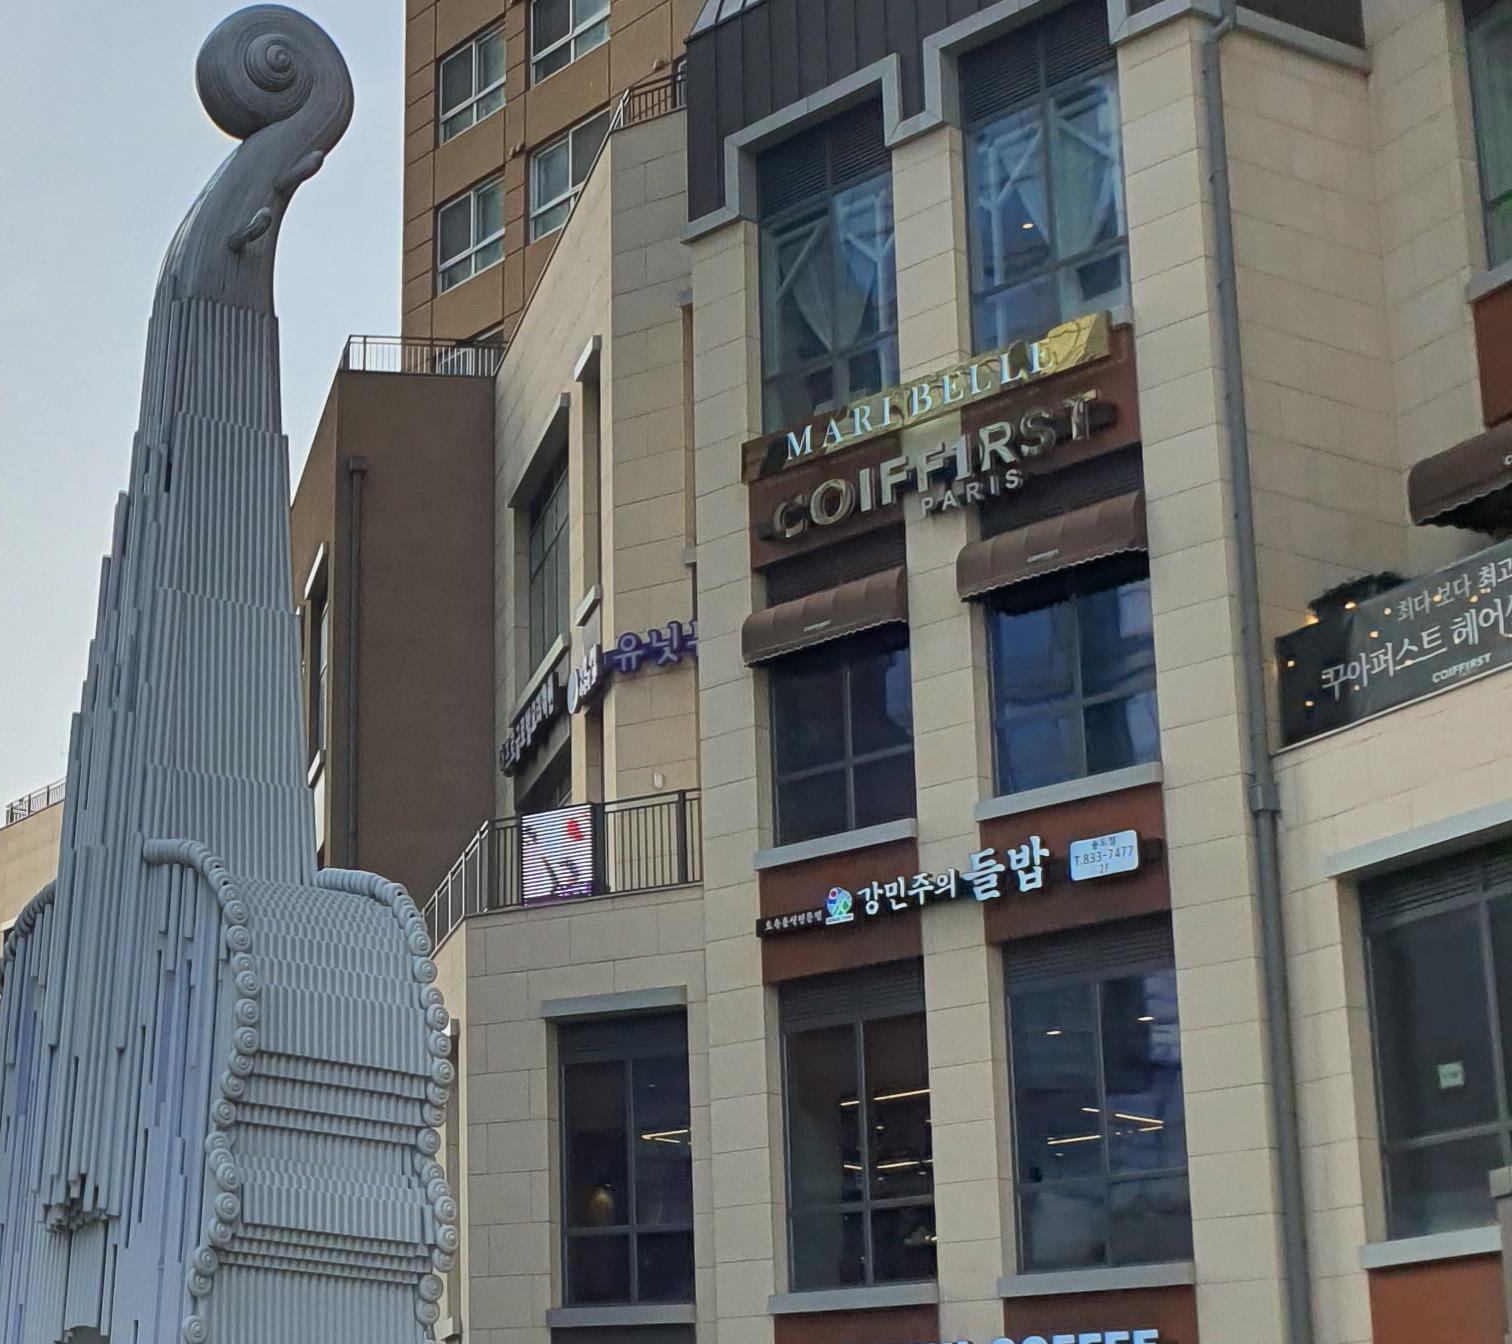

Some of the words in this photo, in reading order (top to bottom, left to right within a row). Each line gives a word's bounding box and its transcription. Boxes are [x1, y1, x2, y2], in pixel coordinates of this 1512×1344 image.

[772, 388, 1098, 539] COIFFIRST
[920, 467, 1026, 518] PARIS
[856, 867, 956, 916] 강민주의
[961, 834, 1051, 902] 들밥
